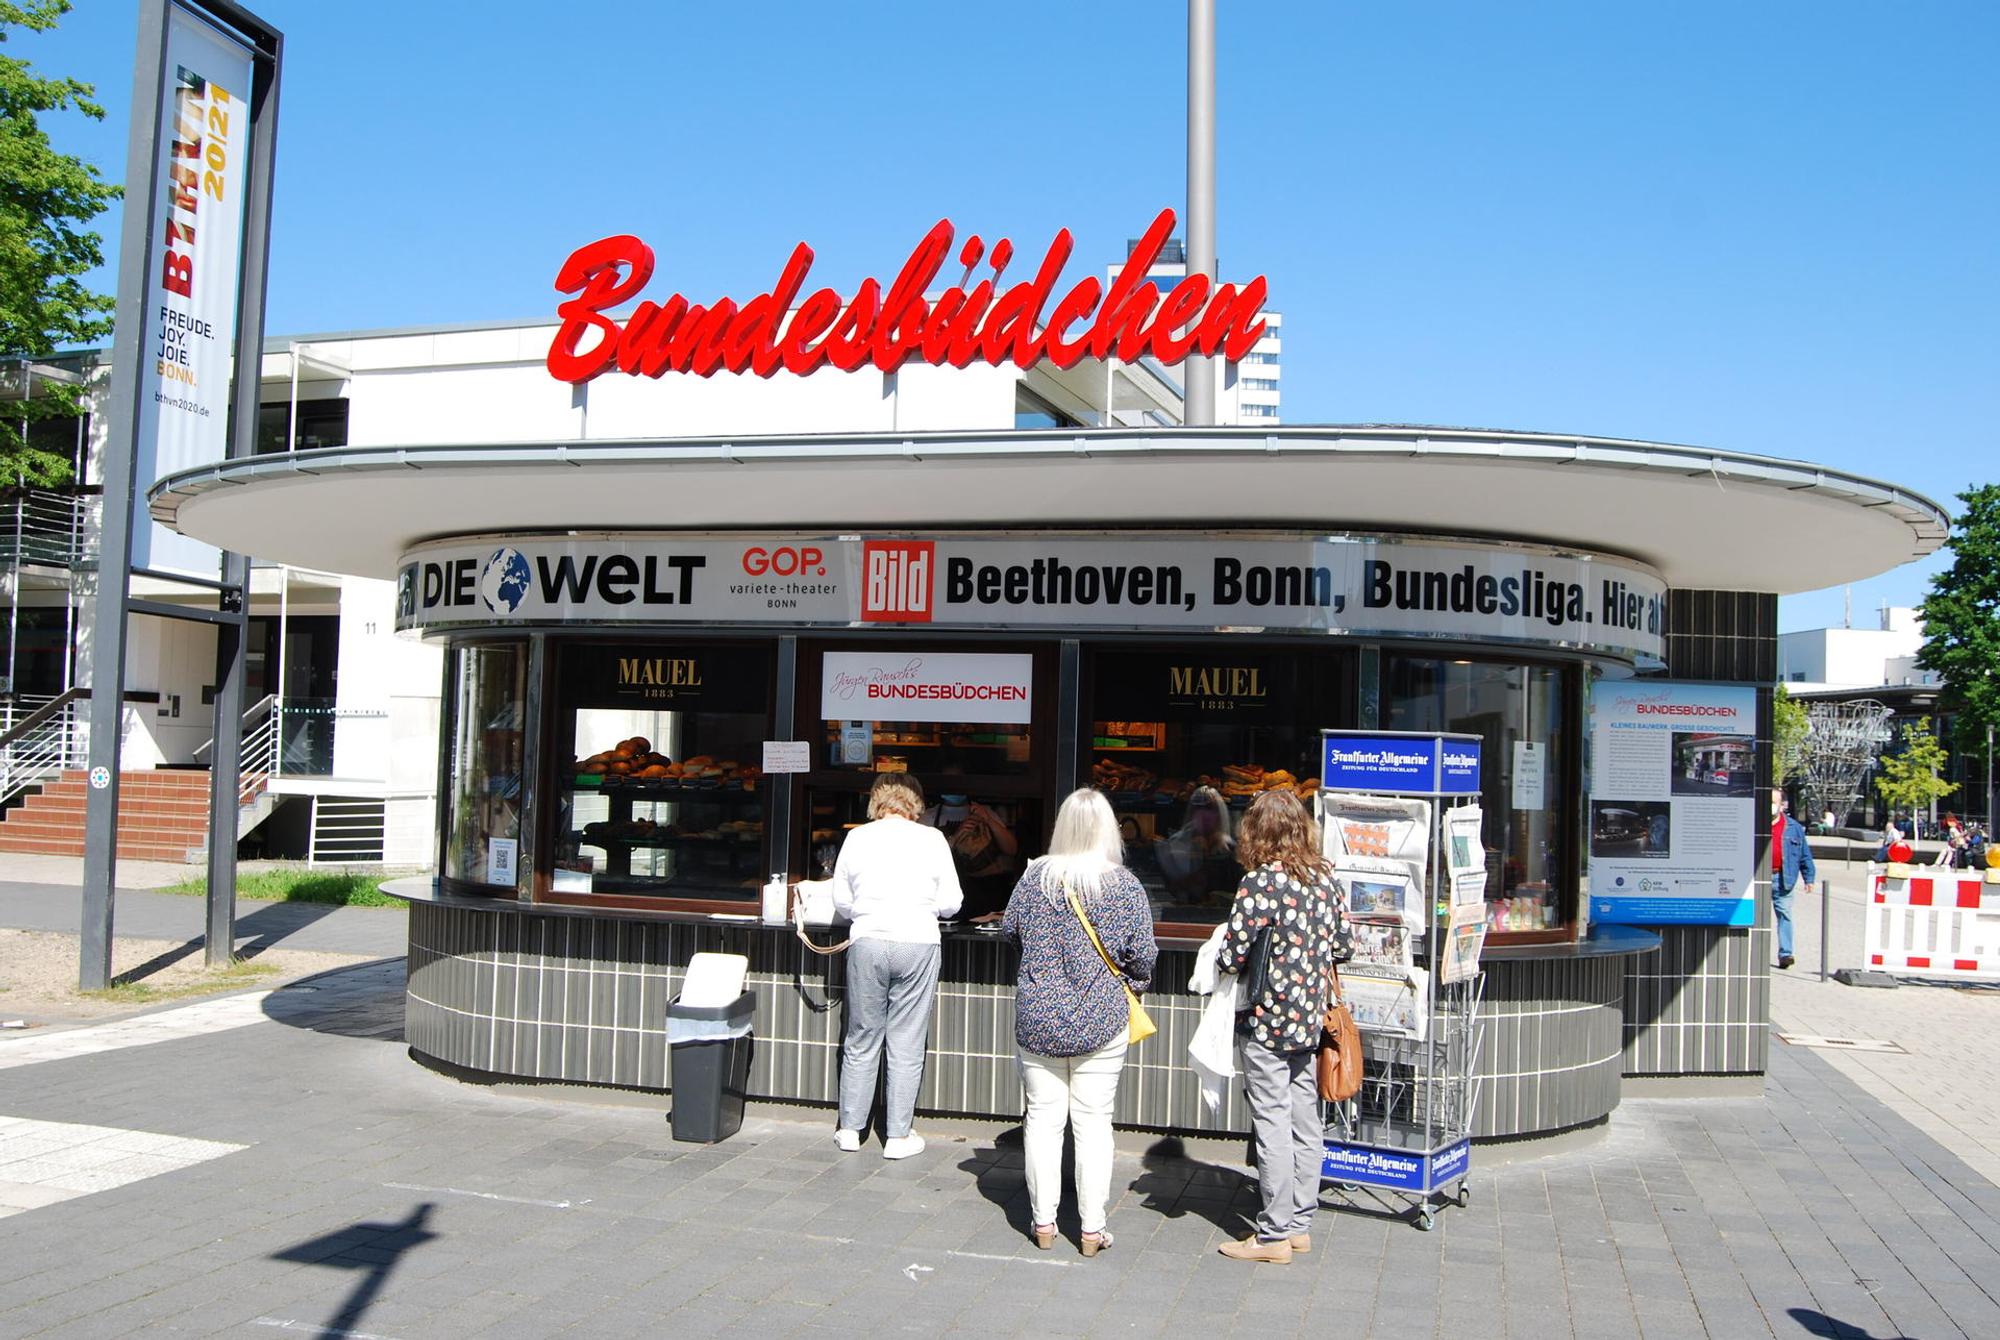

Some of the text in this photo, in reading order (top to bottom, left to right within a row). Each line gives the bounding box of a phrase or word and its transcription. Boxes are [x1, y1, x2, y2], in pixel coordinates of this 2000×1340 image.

[546, 208, 1267, 384] Bundesbüdchen
[160, 306, 215, 340] FREUDE.
[158, 325, 186, 347] JOY.
[157, 343, 190, 367] JOIE.
[156, 360, 197, 387] BONN.
[154, 391, 210, 418] bthvn2020.de
[742, 546, 826, 577] GOP.
[422, 558, 478, 609] DIE
[729, 583, 838, 595] variete-theater
[946, 557, 1196, 612] Beethoven,
[1212, 557, 1346, 614] Bonn,
[1363, 559, 1593, 626] Bundesliga.
[1602, 579, 1645, 631] Hier
[766, 599, 797, 609] BONN
[365, 622, 377, 635] 11
[617, 658, 703, 686] MAUEL
[1169, 667, 1267, 697] MAUEL
[644, 688, 674, 698] 1883
[867, 681, 1027, 701] BUNDESBÜDCHEN
[1200, 700, 1235, 710] 1883
[1636, 703, 1737, 717] BUNDESBÜDCHEN
[1379, 751, 1429, 767] Allgemeine
[1368, 1152, 1418, 1173] Allgemeine
